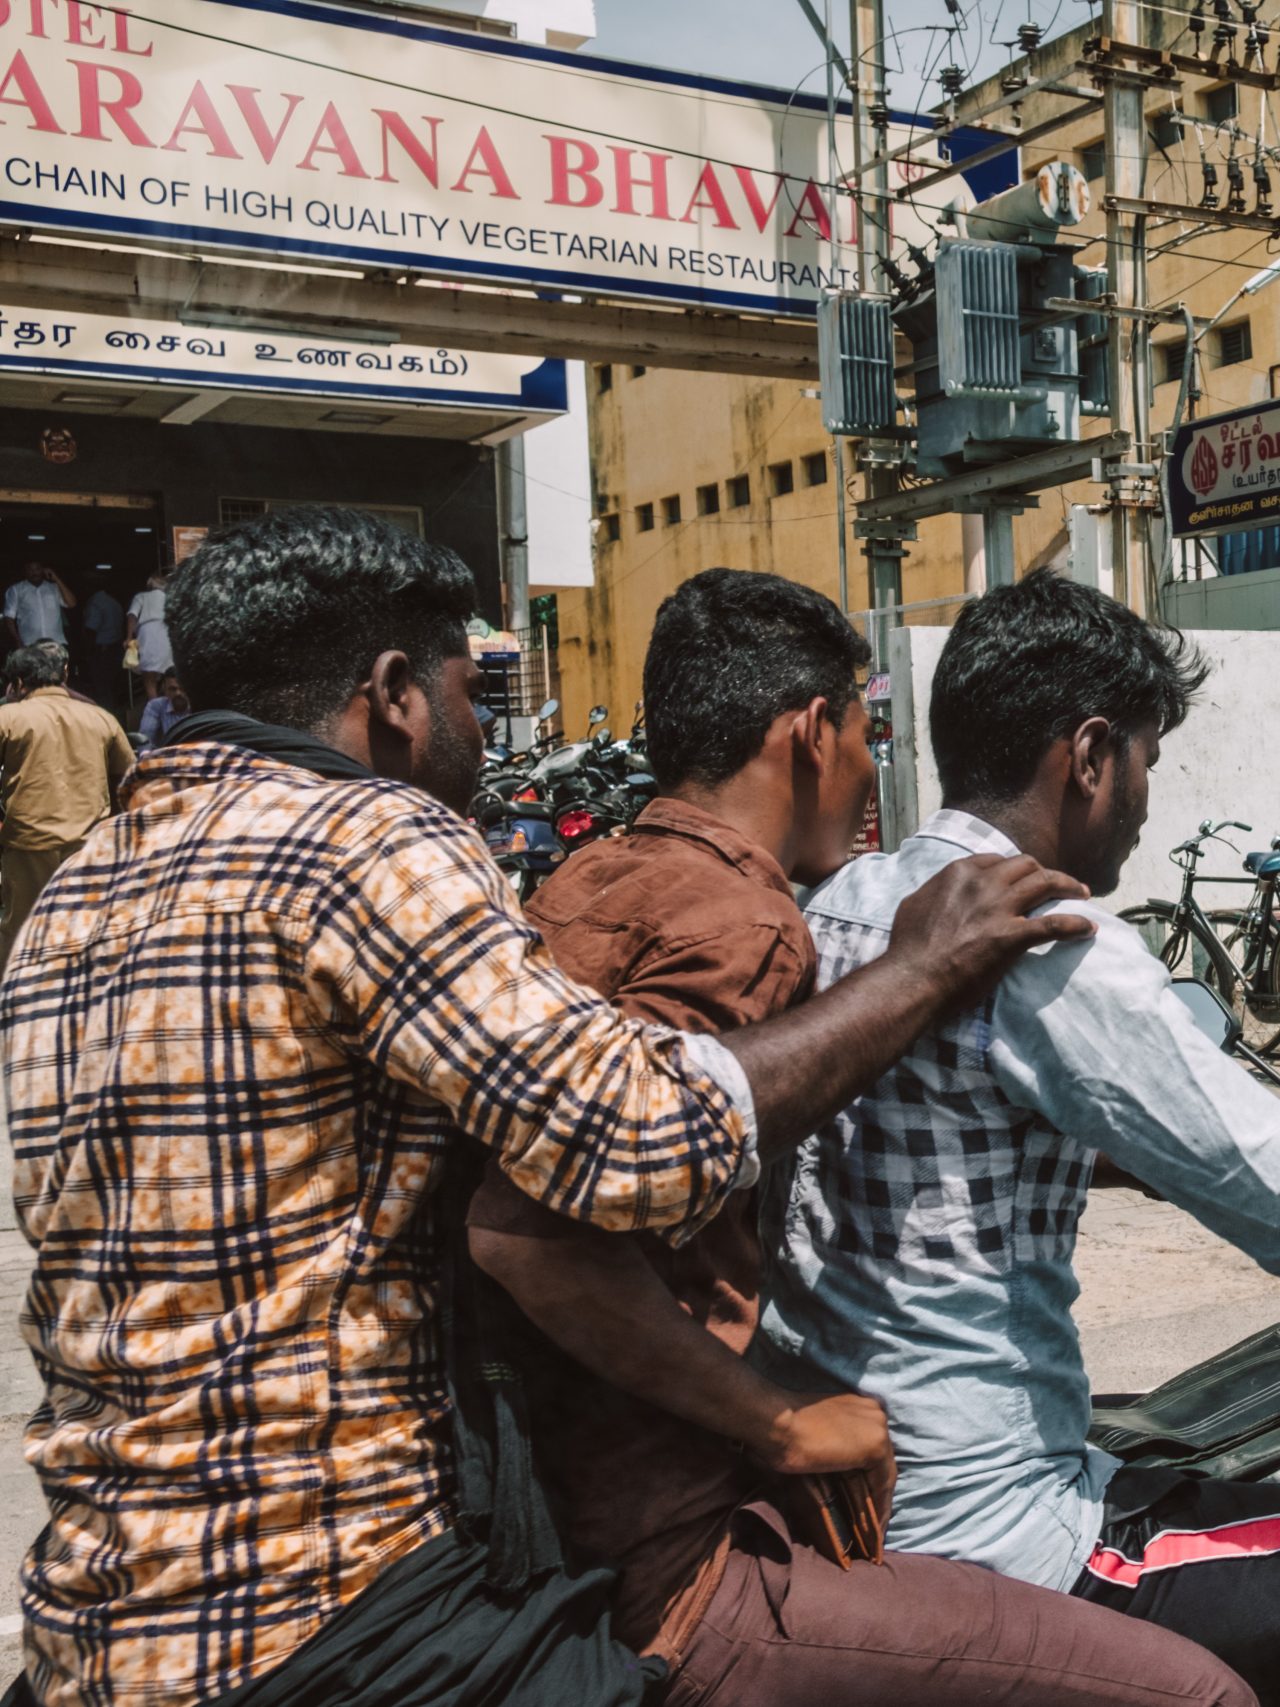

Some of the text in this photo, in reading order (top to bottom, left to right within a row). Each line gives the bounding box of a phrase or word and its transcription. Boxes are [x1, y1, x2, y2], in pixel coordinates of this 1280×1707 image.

[5, 157, 126, 200] CHAIN
[140, 177, 190, 208] OF
[205, 185, 293, 223] HIGH
[305, 200, 449, 242] QUALITY
[459, 219, 658, 268] VEGETARIAN
[105, 331, 226, 357] சைவ
[254, 343, 468, 377] உணவகம்)
